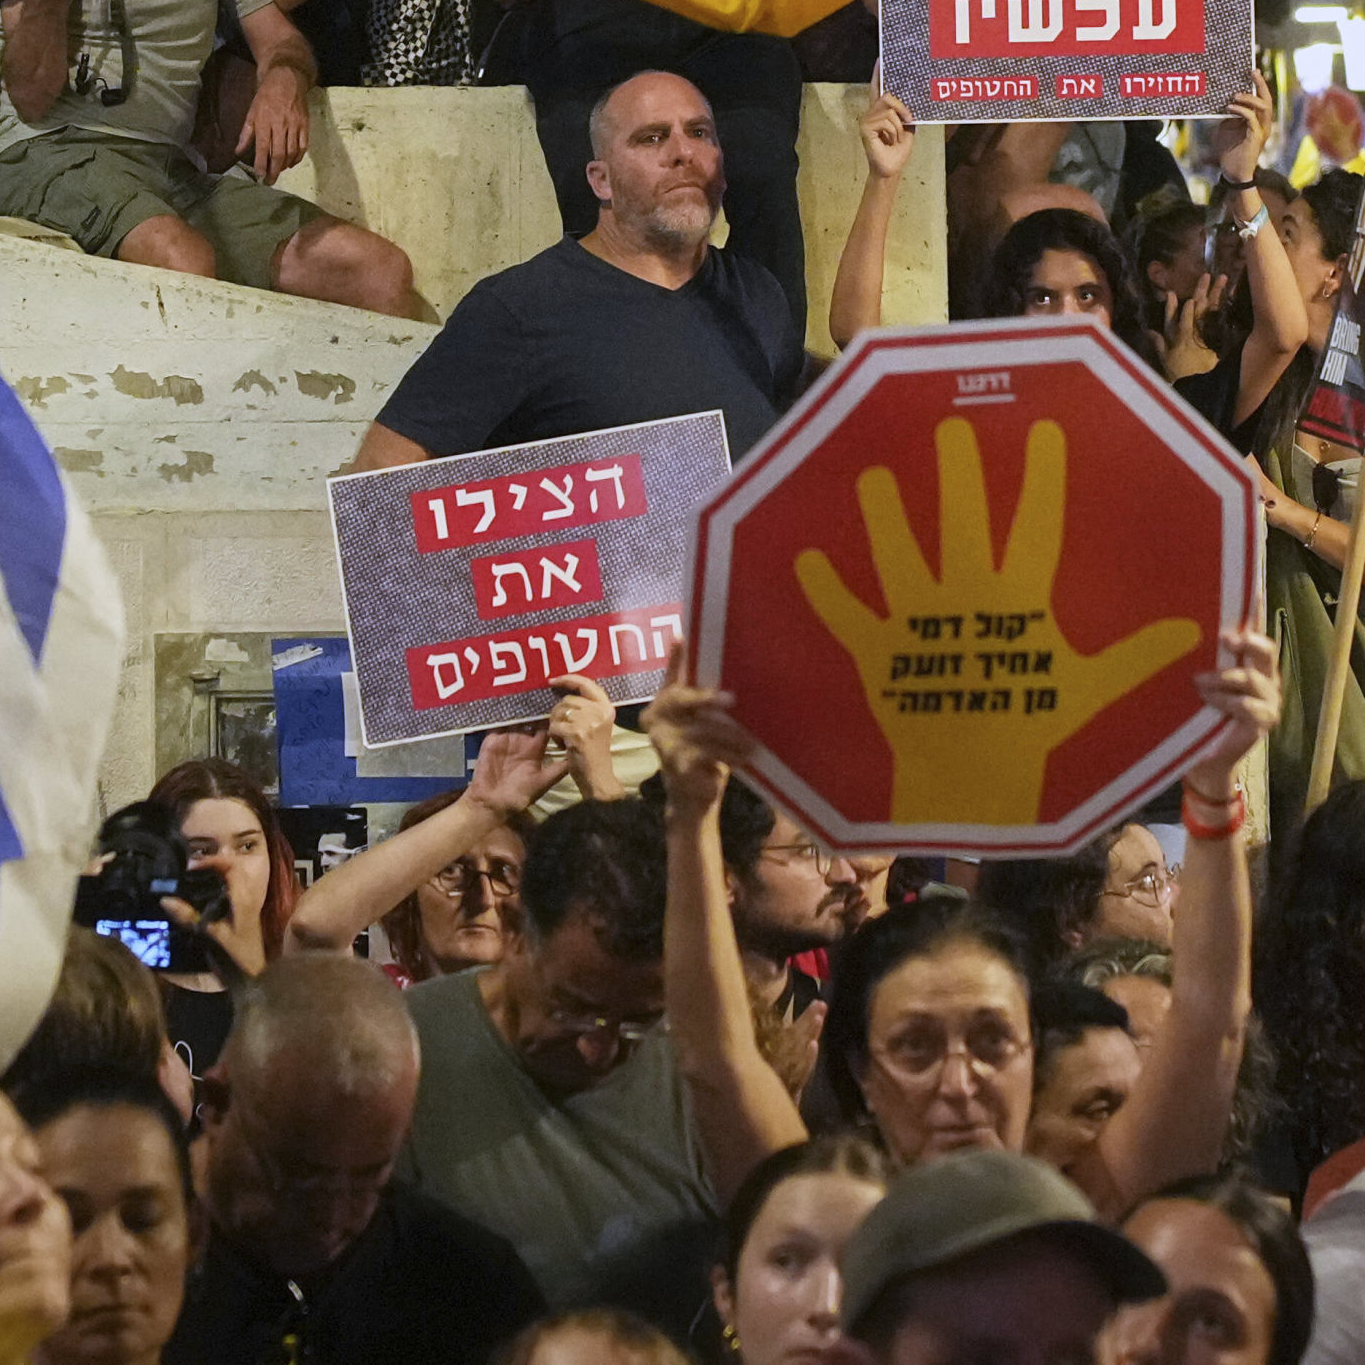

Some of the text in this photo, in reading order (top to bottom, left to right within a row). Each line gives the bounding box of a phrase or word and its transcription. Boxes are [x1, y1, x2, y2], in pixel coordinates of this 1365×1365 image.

[936, 74, 1201, 99] החזירו את החטופים
[1330, 314, 1361, 355] BRING
[1319, 349, 1348, 386] HIM
[427, 463, 625, 540] הצילו
[491, 553, 582, 607] את
[908, 615, 964, 640] דמי
[425, 613, 683, 700] החטופים
[890, 649, 1053, 681] אחיך זועק
[1025, 687, 1058, 715] מן
